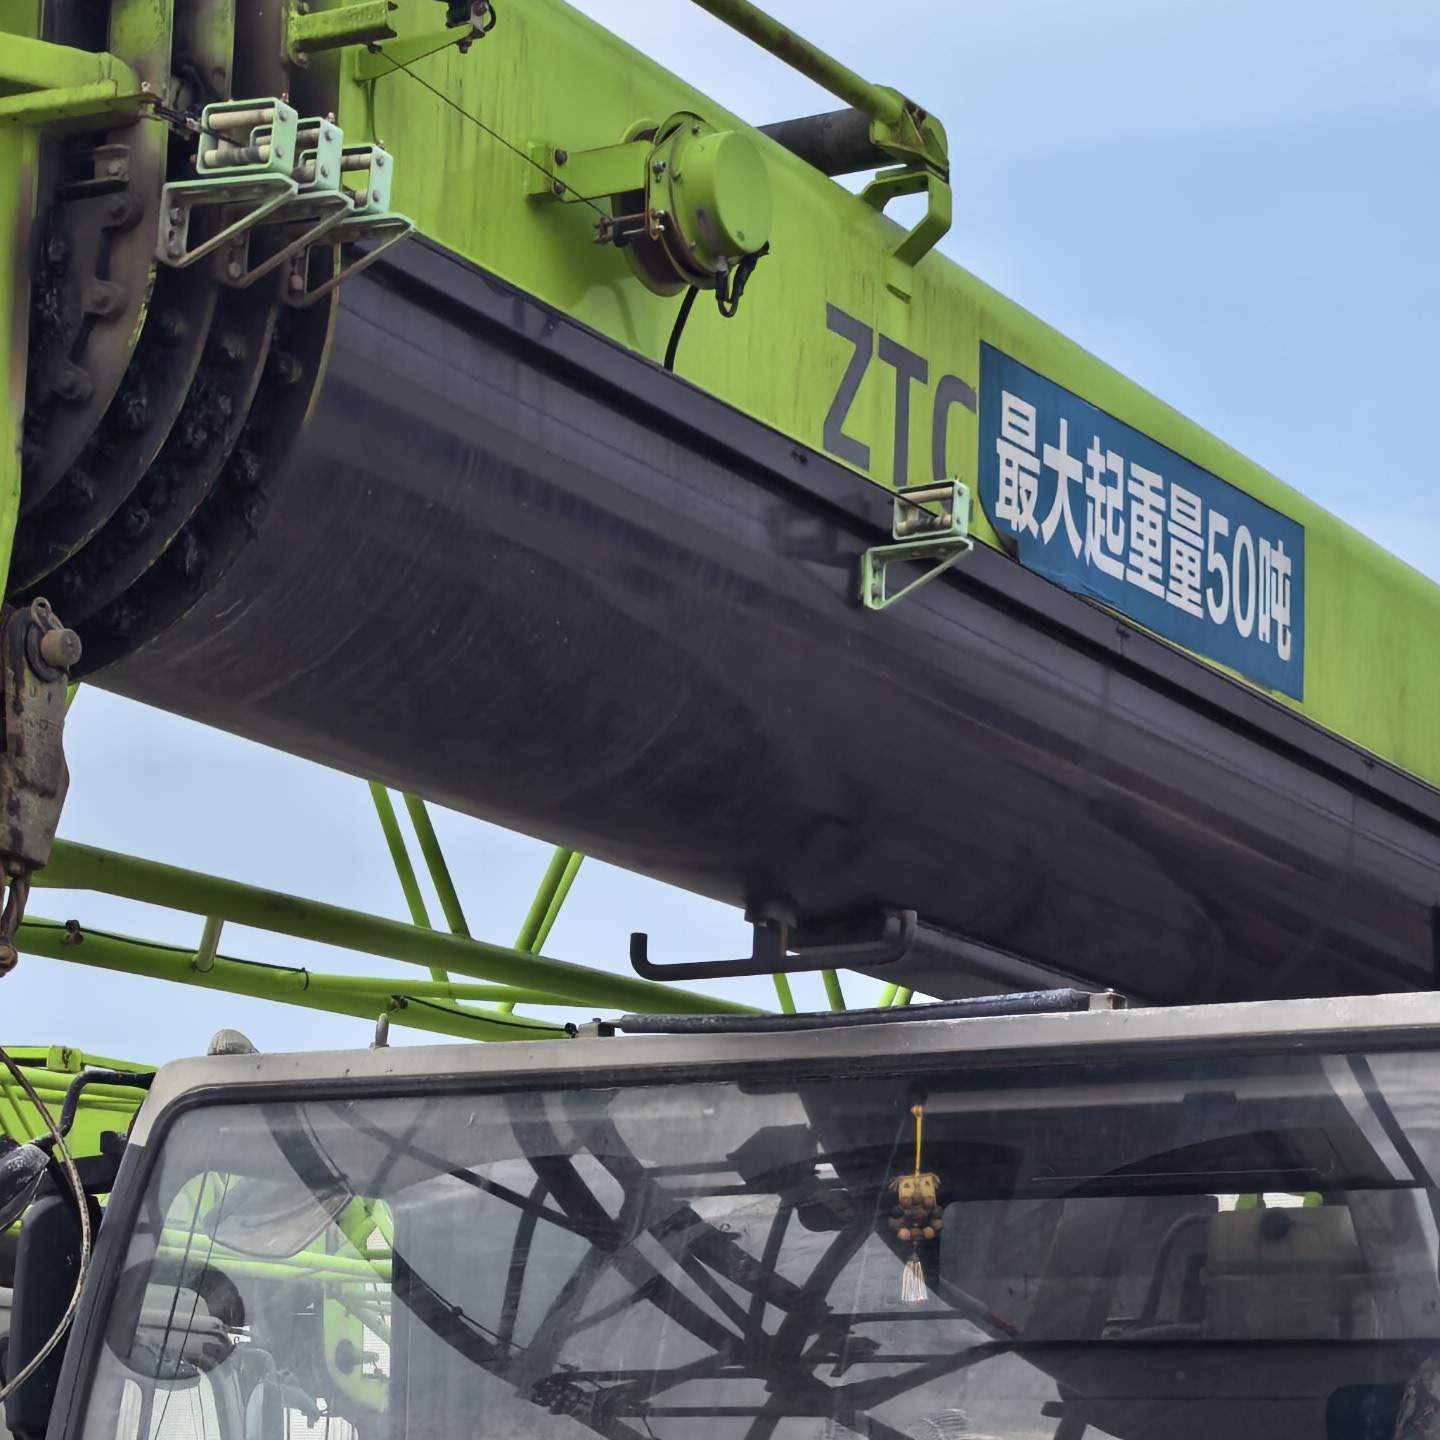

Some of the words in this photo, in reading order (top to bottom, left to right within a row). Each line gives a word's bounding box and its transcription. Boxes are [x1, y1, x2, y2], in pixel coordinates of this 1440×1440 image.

[995, 390, 1292, 661] 最大起重量50吨
